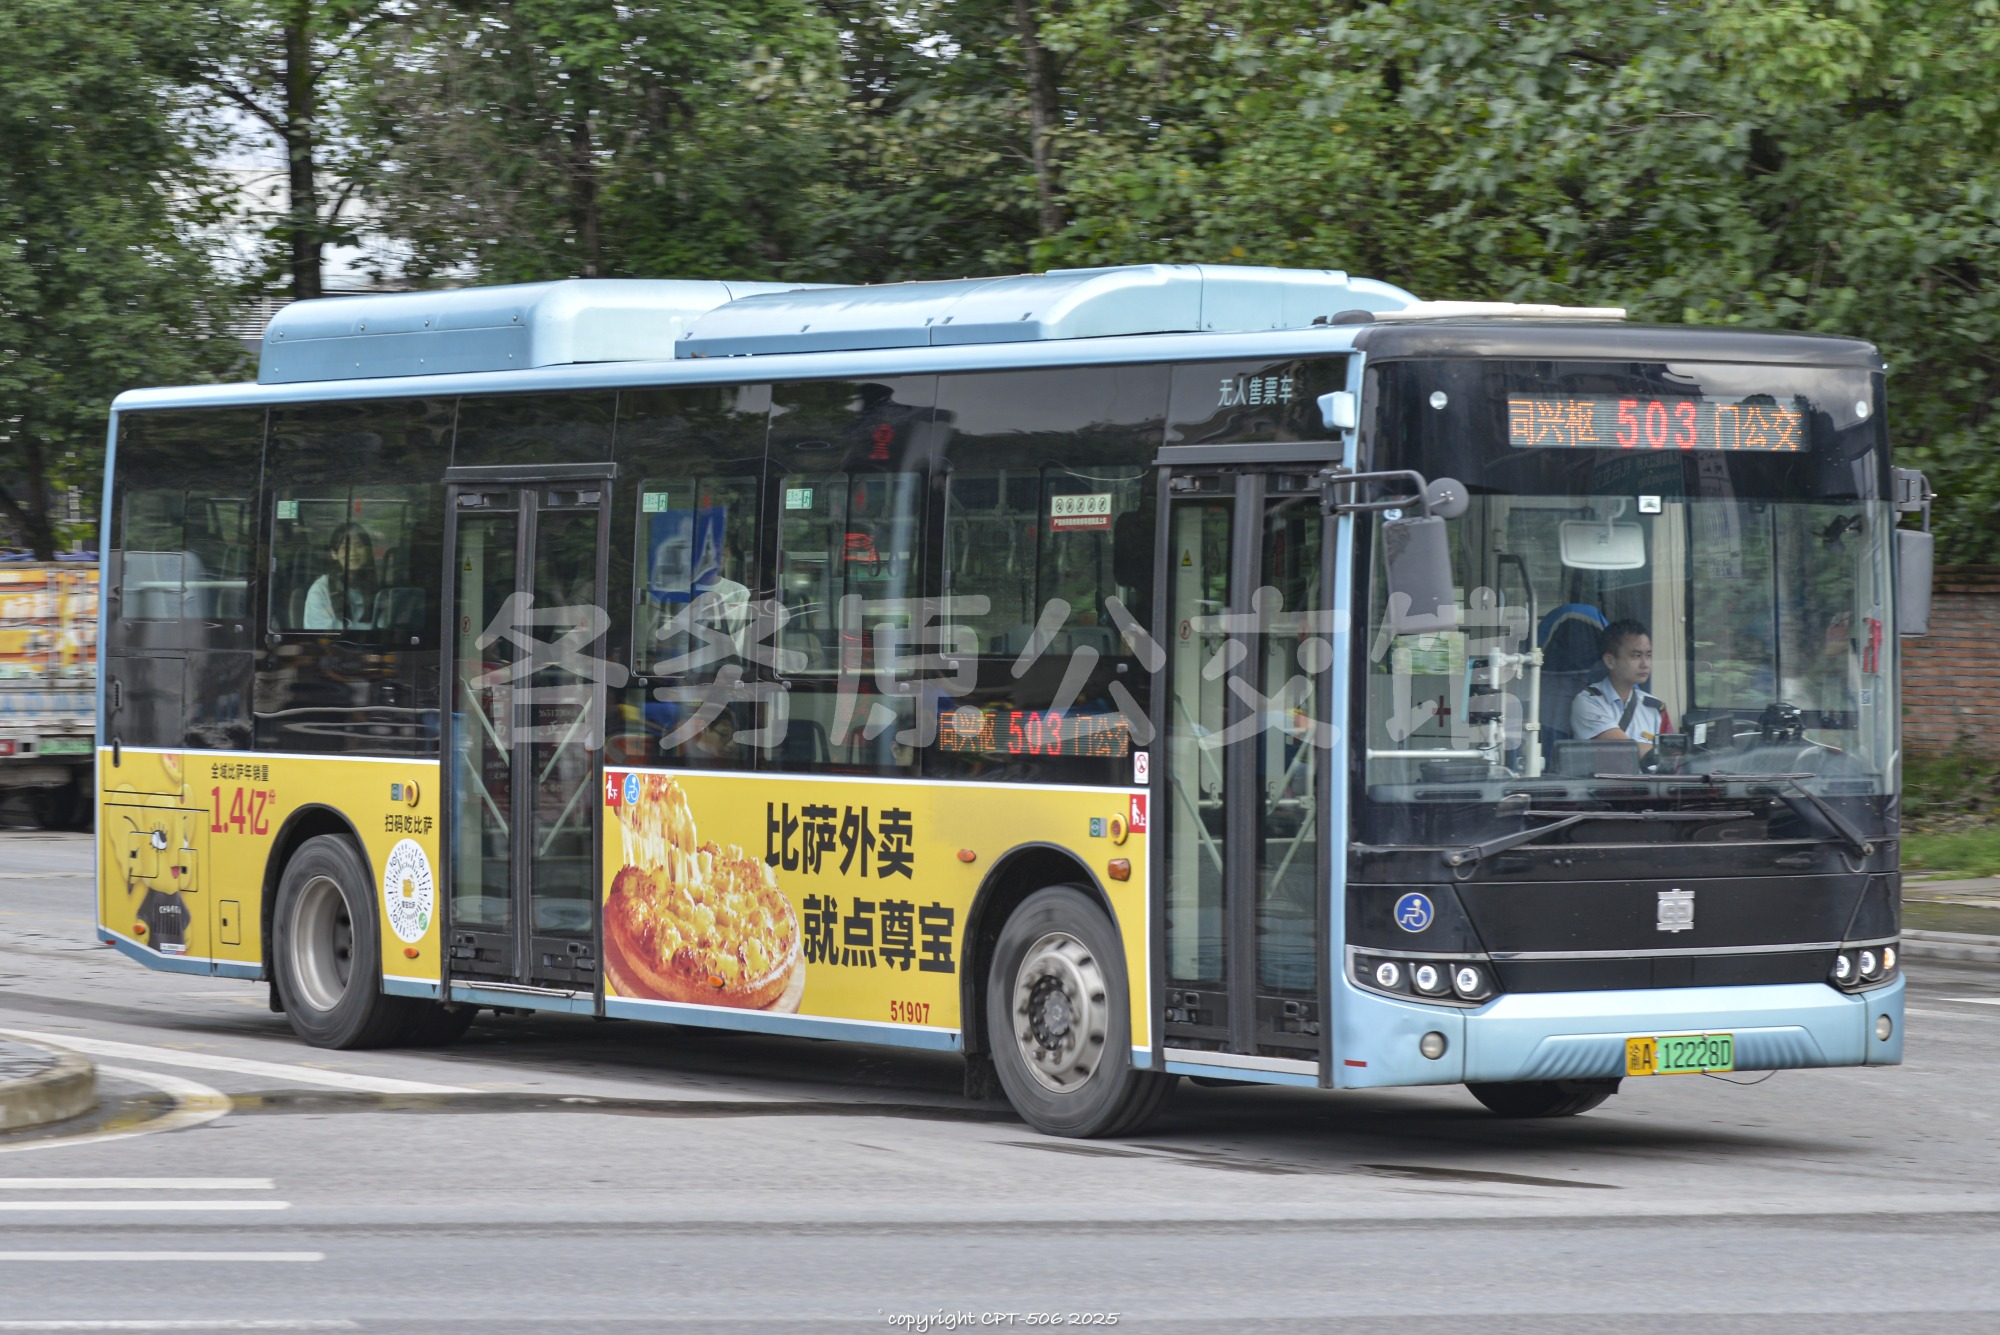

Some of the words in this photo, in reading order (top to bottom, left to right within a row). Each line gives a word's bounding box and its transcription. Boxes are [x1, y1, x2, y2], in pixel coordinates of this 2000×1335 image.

[1218, 375, 1293, 406] 无人售票车
[1616, 399, 1697, 450] 503
[1715, 403, 1802, 451] 门公交
[1008, 711, 1062, 755] 503
[385, 814, 433, 835] 扫码吃比萨
[765, 802, 914, 880] 比萨外卖
[803, 894, 956, 974] 就点尊宝
[890, 1000, 930, 1025] 51907
